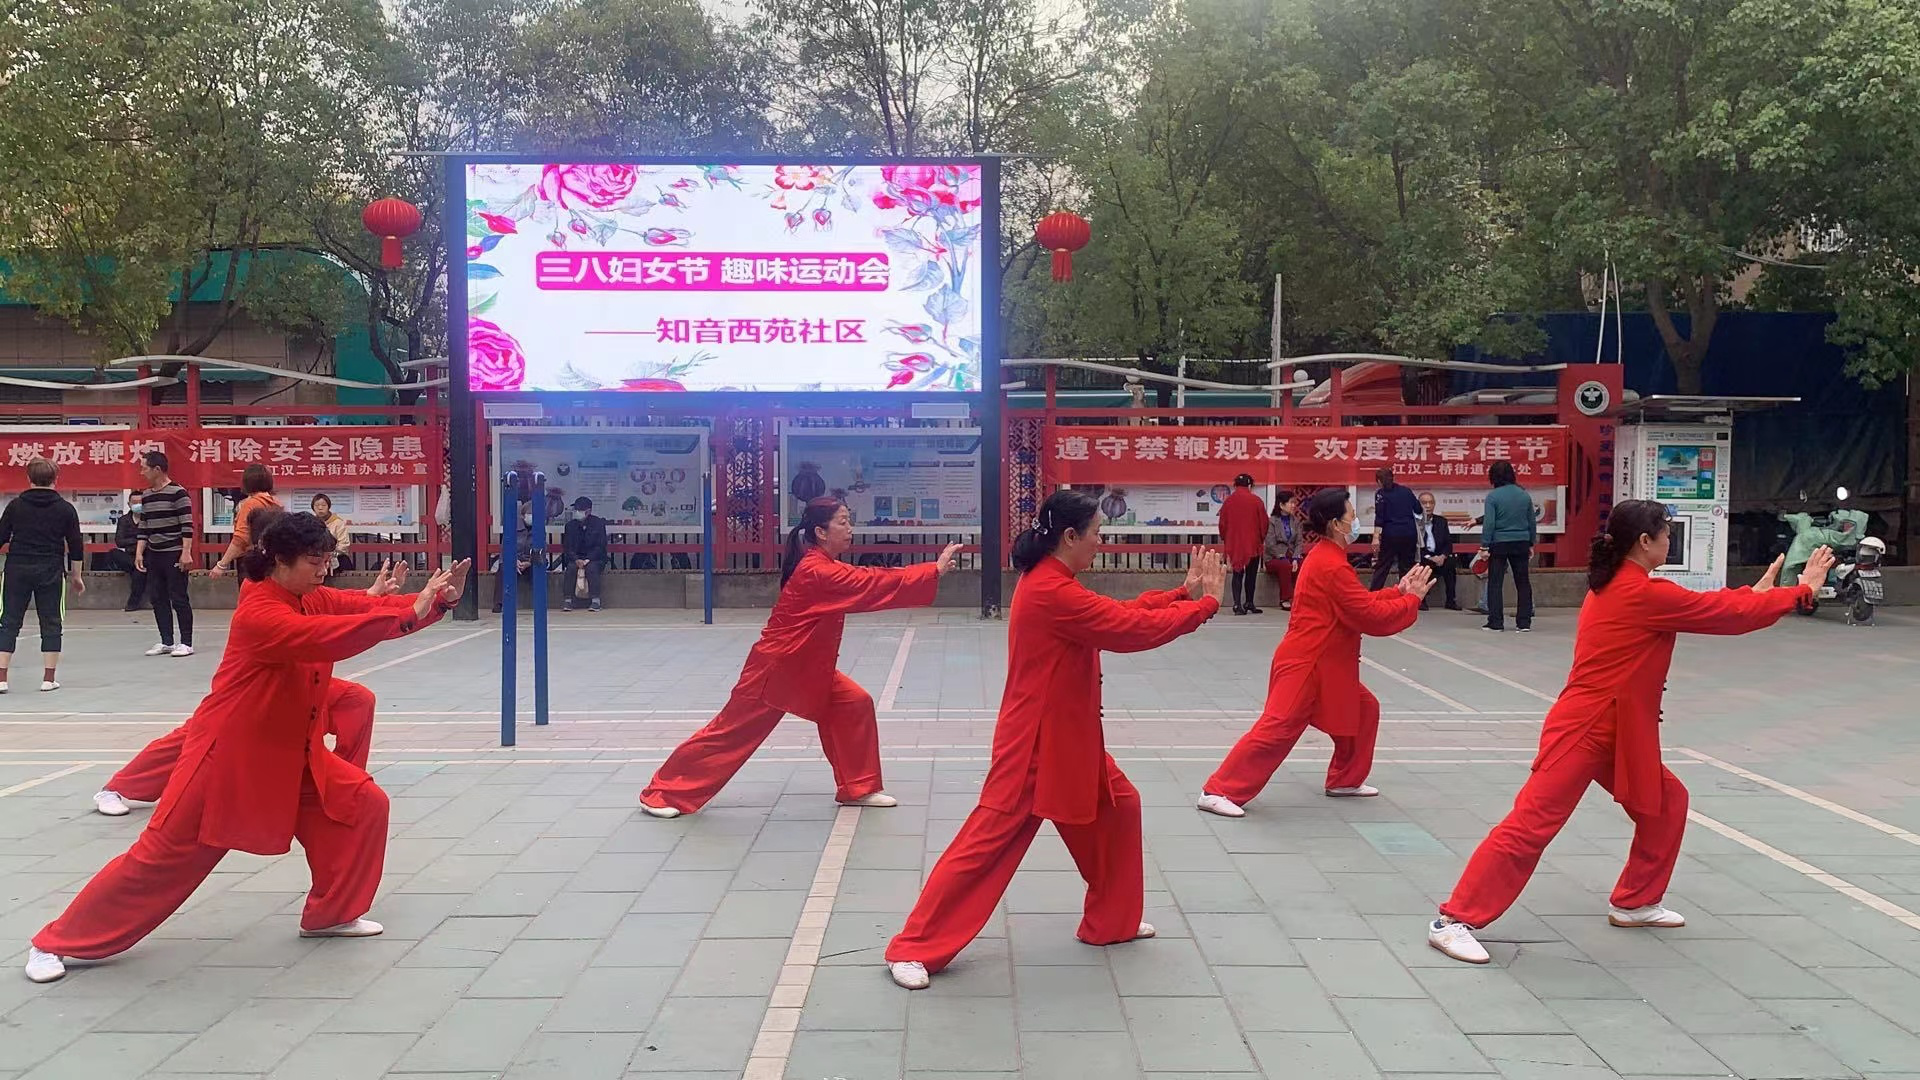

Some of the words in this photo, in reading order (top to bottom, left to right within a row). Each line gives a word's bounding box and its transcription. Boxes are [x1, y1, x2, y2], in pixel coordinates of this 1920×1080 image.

[539, 256, 711, 285] 三八妇女节
[720, 256, 891, 285] 趣味运动会
[0, 440, 165, 466] 燃放鞭炮
[188, 436, 425, 463] 消除安全隐患
[1055, 436, 1289, 460] 遵守禁鞭规定
[1313, 436, 1552, 461] 欢度新春佳节
[413, 463, 427, 475] 宣
[1540, 463, 1554, 475] 宣
